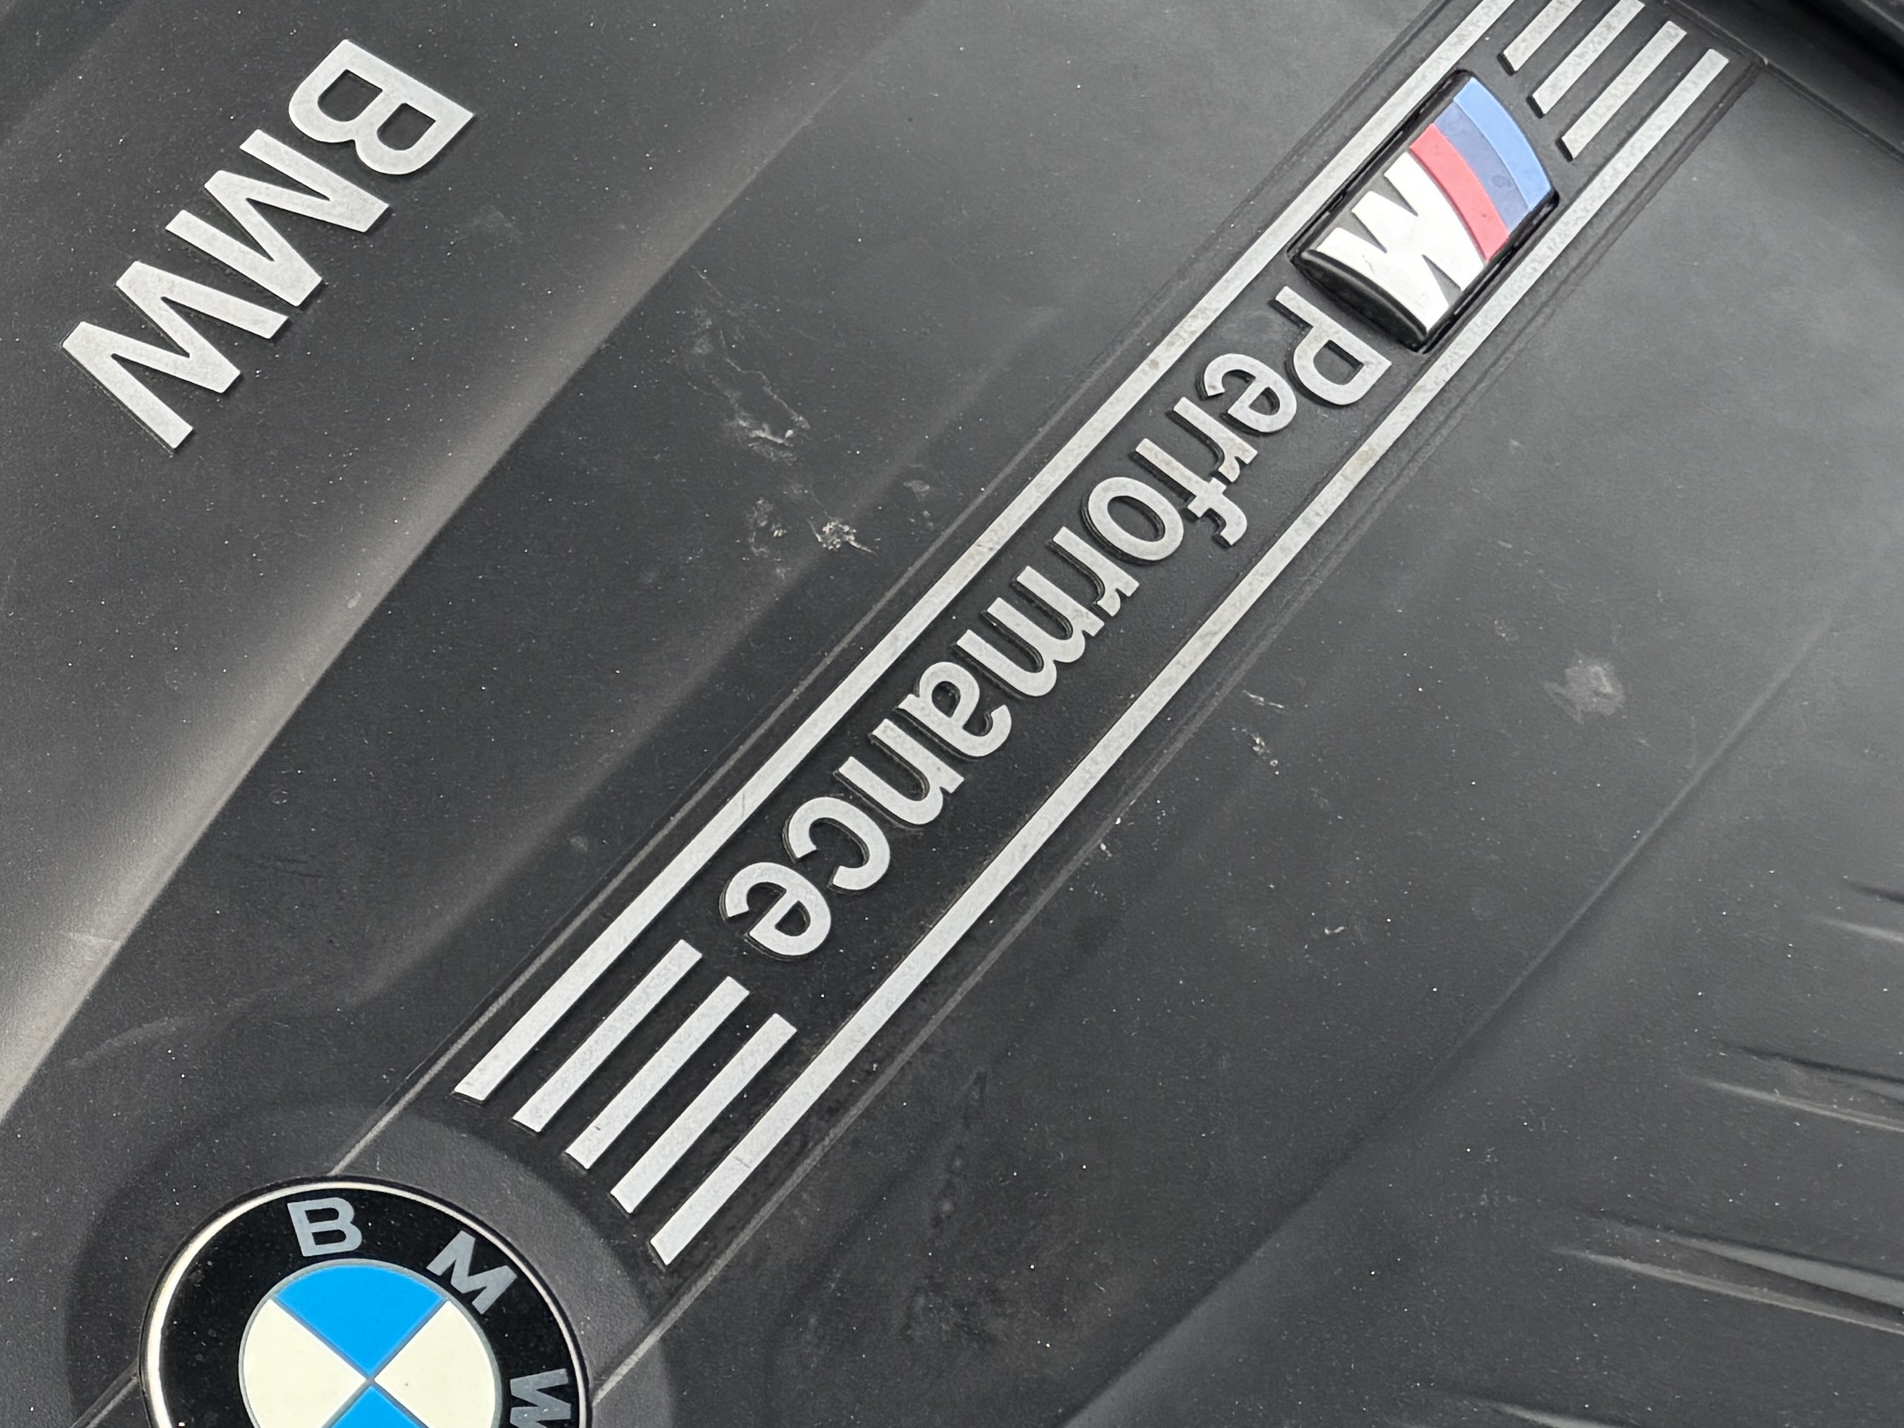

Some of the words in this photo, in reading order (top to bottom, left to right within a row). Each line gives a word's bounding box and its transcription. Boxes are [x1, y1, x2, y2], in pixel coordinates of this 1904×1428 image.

[63, 38, 476, 450] BMW
[1316, 152, 1484, 338] M
[719, 287, 1394, 961] Performance
